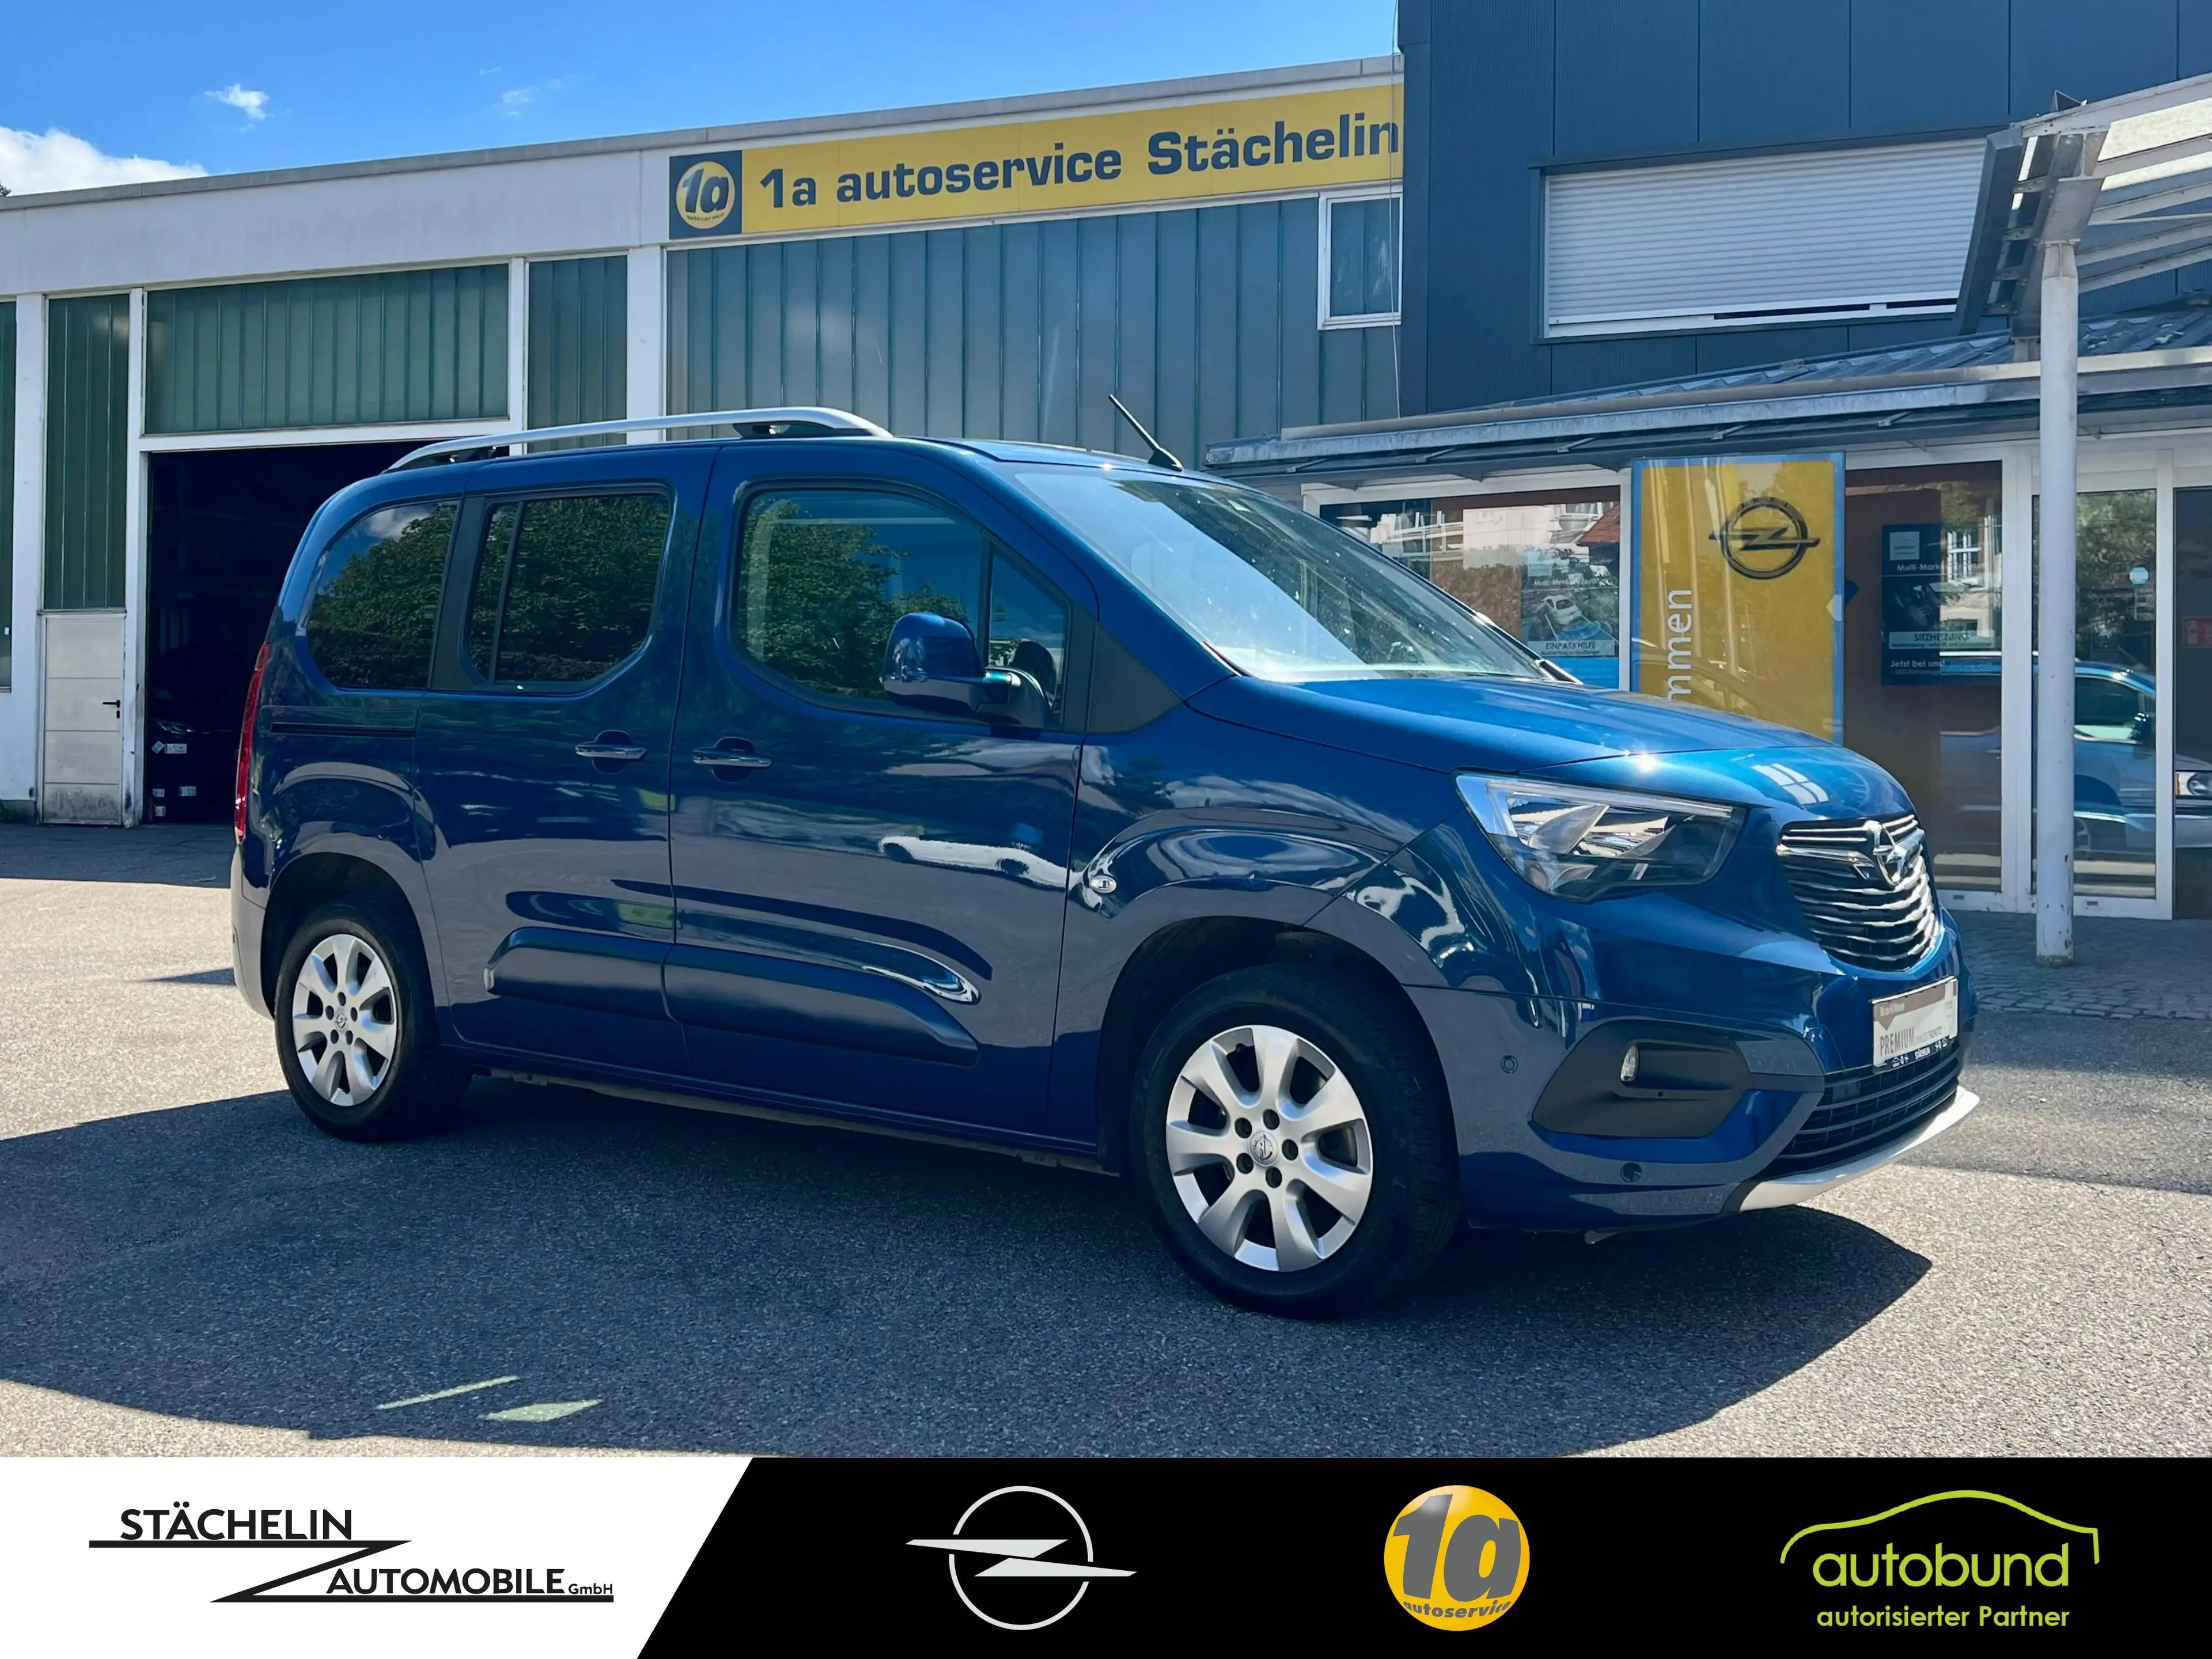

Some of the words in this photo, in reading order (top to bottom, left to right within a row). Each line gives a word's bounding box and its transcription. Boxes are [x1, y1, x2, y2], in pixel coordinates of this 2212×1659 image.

[760, 168, 817, 208] 1a
[836, 142, 1122, 204] autoservice
[1147, 112, 1399, 175] Stächelin
[682, 168, 729, 213] 1a
[1880, 1027, 1915, 1057] PREMIUM
